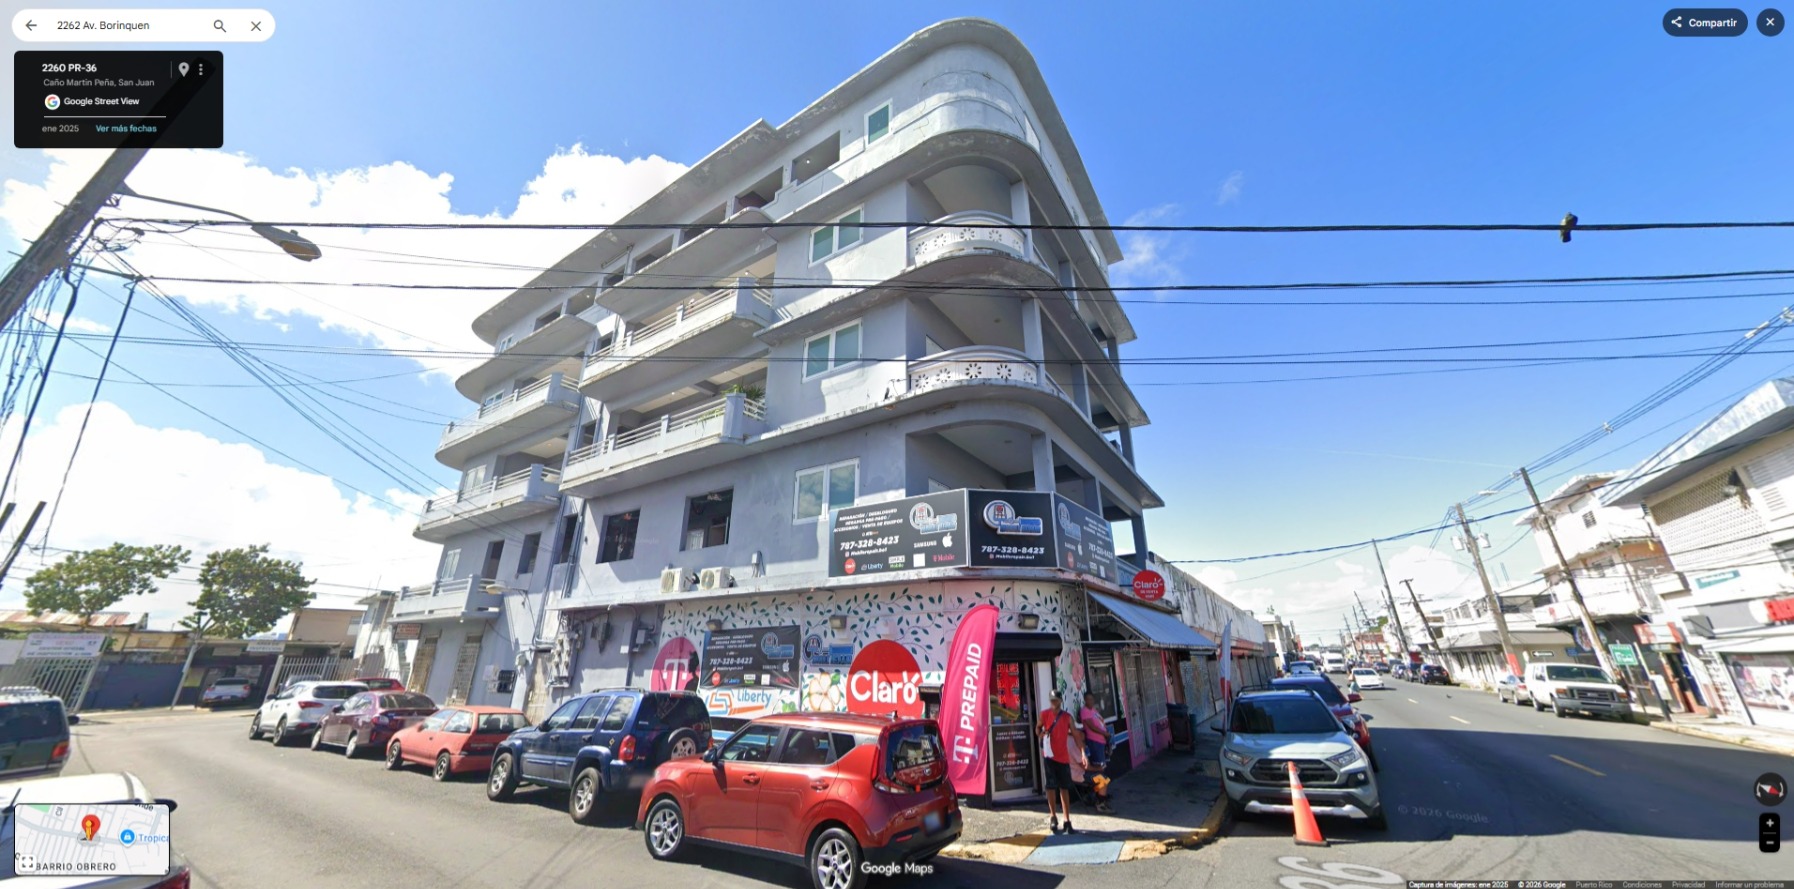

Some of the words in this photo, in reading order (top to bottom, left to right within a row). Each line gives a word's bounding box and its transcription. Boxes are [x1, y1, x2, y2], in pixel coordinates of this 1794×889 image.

[840, 535, 900, 551] 787-328-8423
[913, 540, 938, 549] SAMSUNG
[981, 545, 1045, 555] 787-328-8423
[1134, 578, 1161, 589] Claro
[850, 670, 918, 704] Claro
[960, 643, 982, 732] PREPAID
